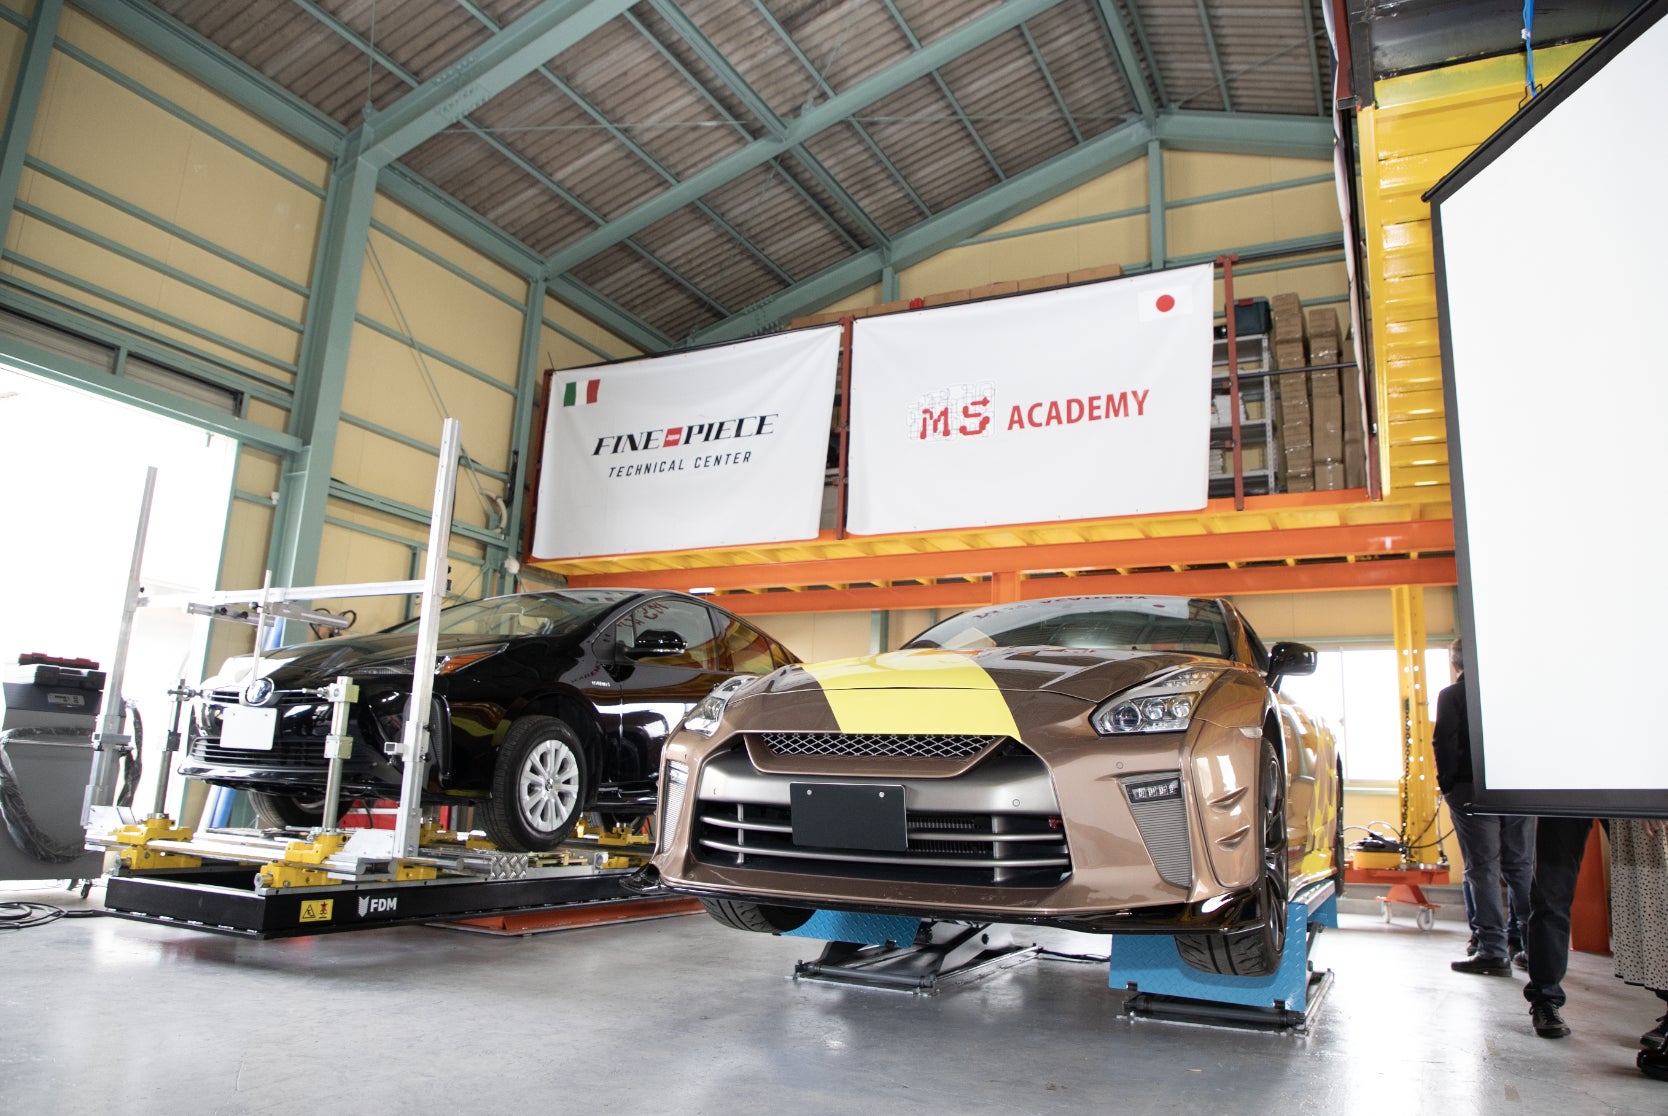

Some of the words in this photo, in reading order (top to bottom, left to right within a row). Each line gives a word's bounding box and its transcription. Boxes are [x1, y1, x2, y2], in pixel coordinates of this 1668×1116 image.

[920, 396, 990, 439] MS
[1007, 389, 1149, 430] ACADEMY
[592, 429, 664, 456] FINE
[683, 414, 779, 445] PIECE
[608, 459, 684, 478] TECHNICAL
[694, 451, 752, 469] CENTER
[370, 897, 397, 912] FDM
